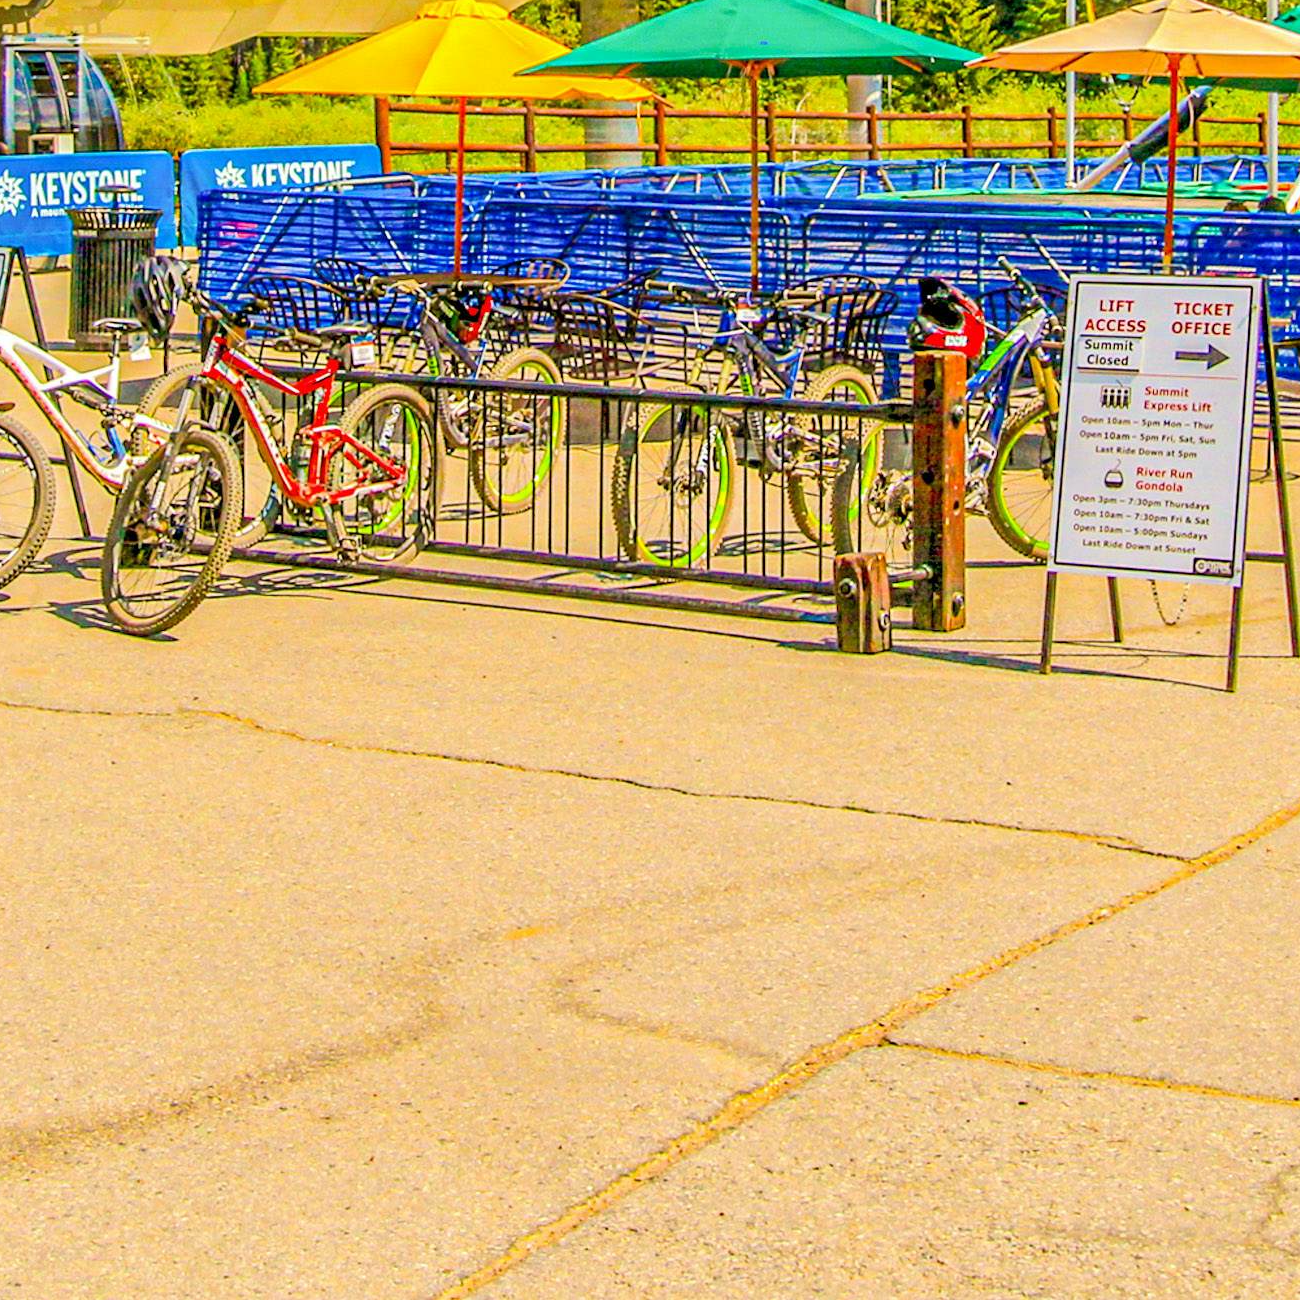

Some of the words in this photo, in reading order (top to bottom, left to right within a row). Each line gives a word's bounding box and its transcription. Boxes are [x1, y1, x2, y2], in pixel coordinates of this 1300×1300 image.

[31, 208, 38, 218] A
[1099, 300, 1134, 313] LIFT
[1174, 302, 1234, 316] TICKET
[1085, 318, 1146, 333] ACCESS
[1171, 321, 1232, 335] OFFICE
[1085, 339, 1134, 351] Summit
[1087, 354, 1129, 366] Closed
[1145, 386, 1189, 397] Summit
[1144, 400, 1188, 412] Express
[1192, 402, 1212, 413] Lift
[1081, 415, 1104, 424] Open
[1107, 417, 1131, 426] 10am
[1141, 419, 1160, 428] 5pm
[1164, 420, 1182, 428] Mon
[1193, 421, 1214, 430] Thur
[1080, 430, 1102, 440] Open
[1104, 431, 1130, 441] 10am
[1140, 434, 1159, 443] 5pm
[1179, 436, 1196, 445] Sat,
[1199, 437, 1216, 445] Sun
[1116, 446, 1136, 455] Ride
[1138, 448, 1163, 457] Down
[1178, 450, 1198, 459] 5pm
[1136, 467, 1167, 478] River
[1170, 469, 1193, 479] Run
[1135, 481, 1184, 492] Gondola
[1073, 494, 1096, 503] Open
[1128, 498, 1162, 508] 7:30pm
[1165, 500, 1210, 511] Thursdays
[1073, 509, 1097, 518] Open
[1100, 511, 1124, 519] 10am
[1134, 513, 1168, 523] 7:30pm
[1171, 515, 1183, 523] Fri
[1185, 516, 1192, 524] &
[1194, 517, 1210, 525] Sat
[1073, 524, 1096, 533] Open
[1099, 526, 1123, 534] 10am
[1133, 528, 1168, 538] 5:00pm
[1170, 530, 1208, 541] Sundays
[1083, 539, 1101, 547] Last
[1103, 541, 1123, 549] Ride
[1125, 542, 1151, 550] Down
[1153, 544, 1163, 552] at
[1165, 545, 1196, 554] Sunset
